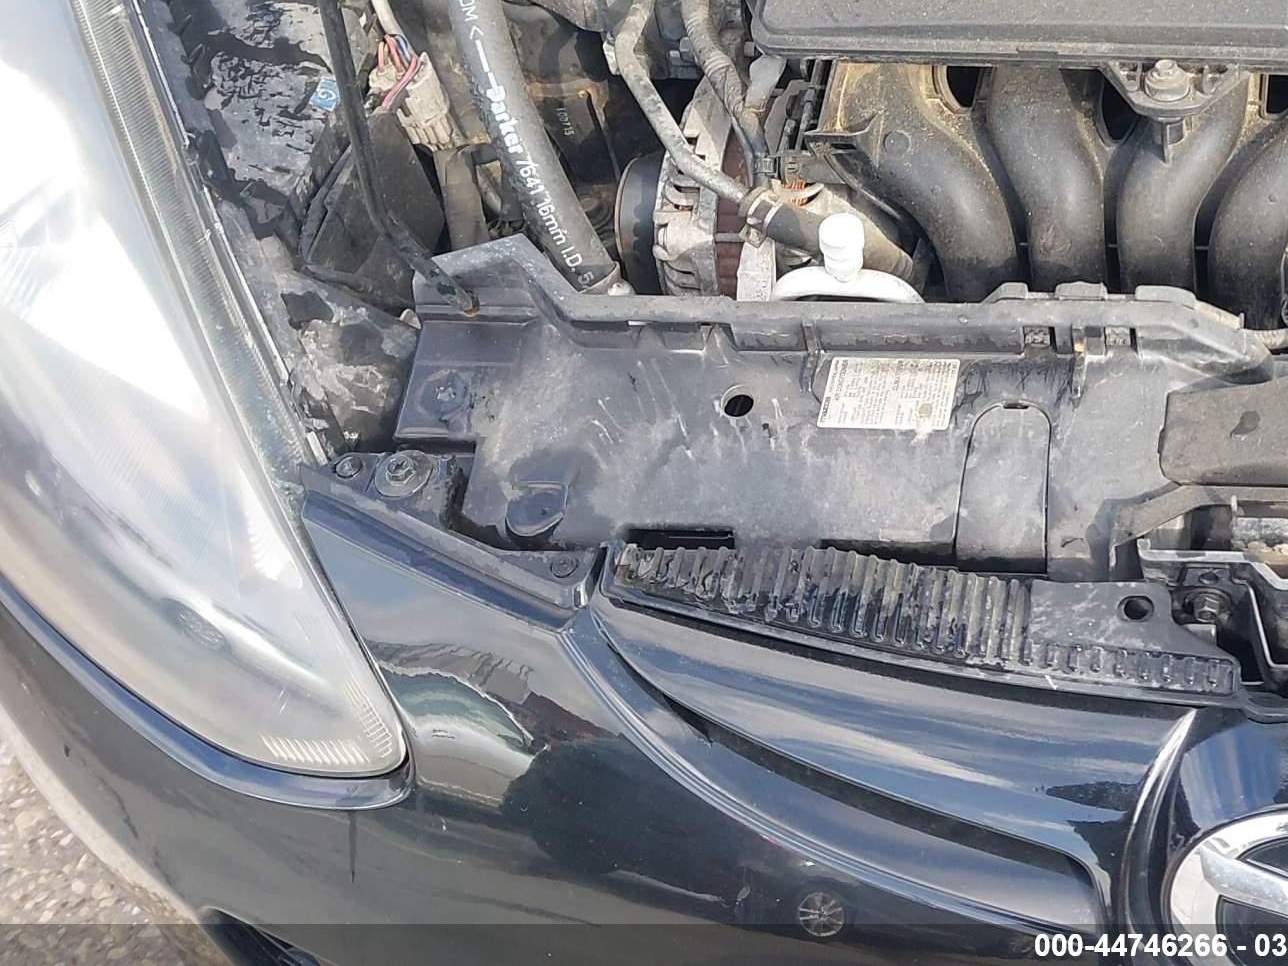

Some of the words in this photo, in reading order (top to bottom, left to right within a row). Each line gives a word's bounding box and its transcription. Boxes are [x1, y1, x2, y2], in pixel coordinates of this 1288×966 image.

[486, 85, 525, 155] Parker
[537, 199, 568, 247] 16mm
[561, 247, 583, 273] I.D.
